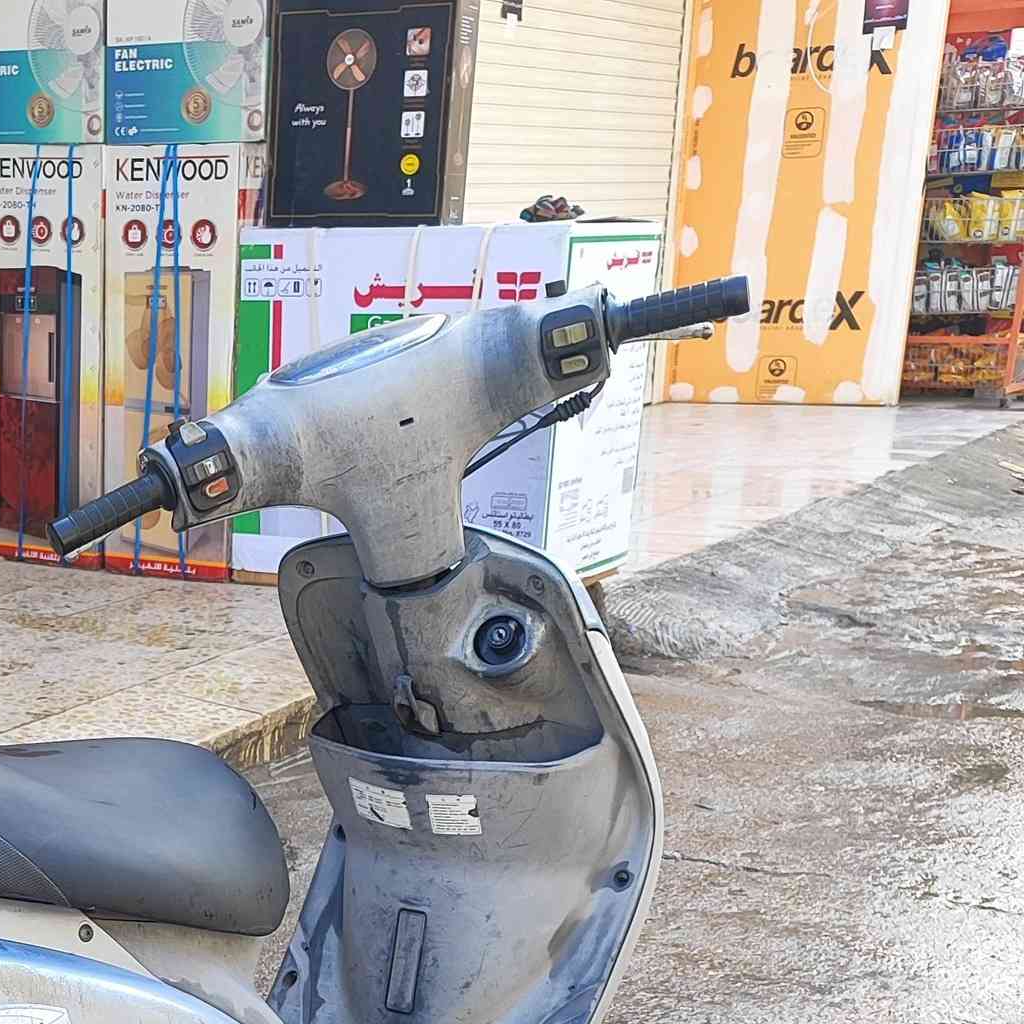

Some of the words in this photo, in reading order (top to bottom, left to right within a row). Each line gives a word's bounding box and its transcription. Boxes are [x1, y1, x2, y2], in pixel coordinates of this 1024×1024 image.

[115, 48, 137, 59] FAN
[115, 59, 174, 72] ELECTRIC
[294, 103, 325, 115] Always
[291, 118, 311, 127] with
[312, 118, 327, 129] you
[115, 191, 143, 200] Water
